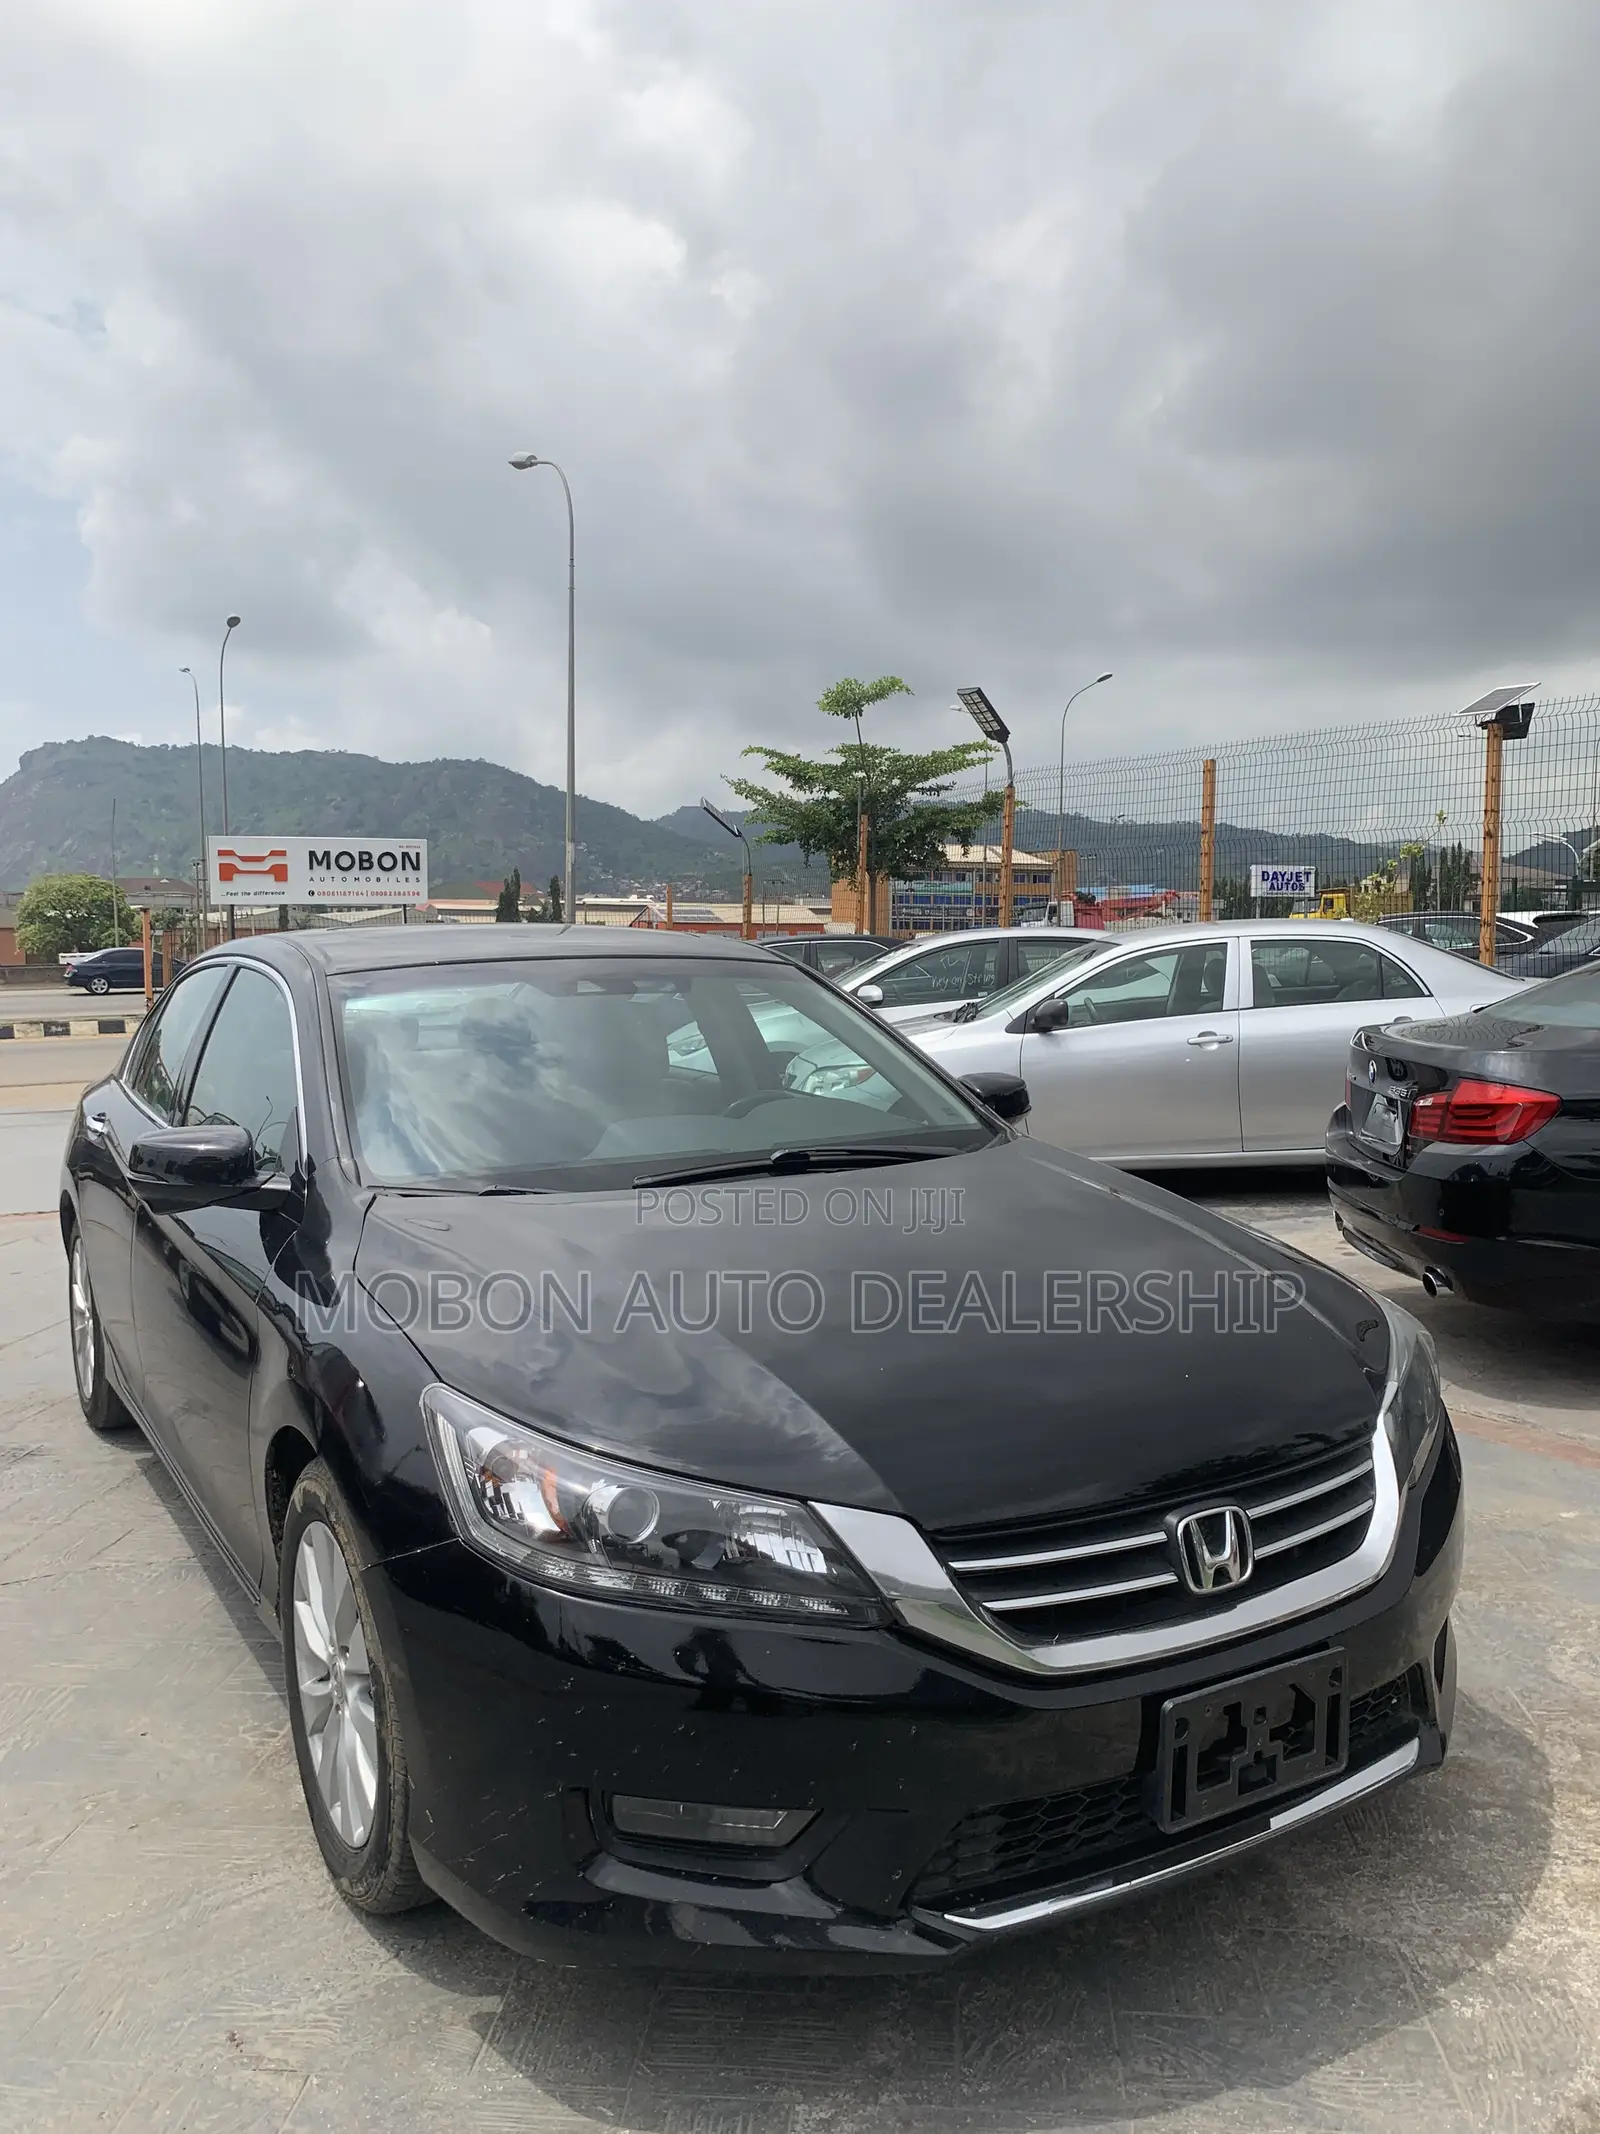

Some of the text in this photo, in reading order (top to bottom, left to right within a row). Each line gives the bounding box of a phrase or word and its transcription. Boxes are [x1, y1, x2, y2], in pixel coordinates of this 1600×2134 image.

[308, 850, 421, 872] MOBON
[1261, 871, 1311, 882] DAYJET
[1269, 882, 1305, 891] AUTOS
